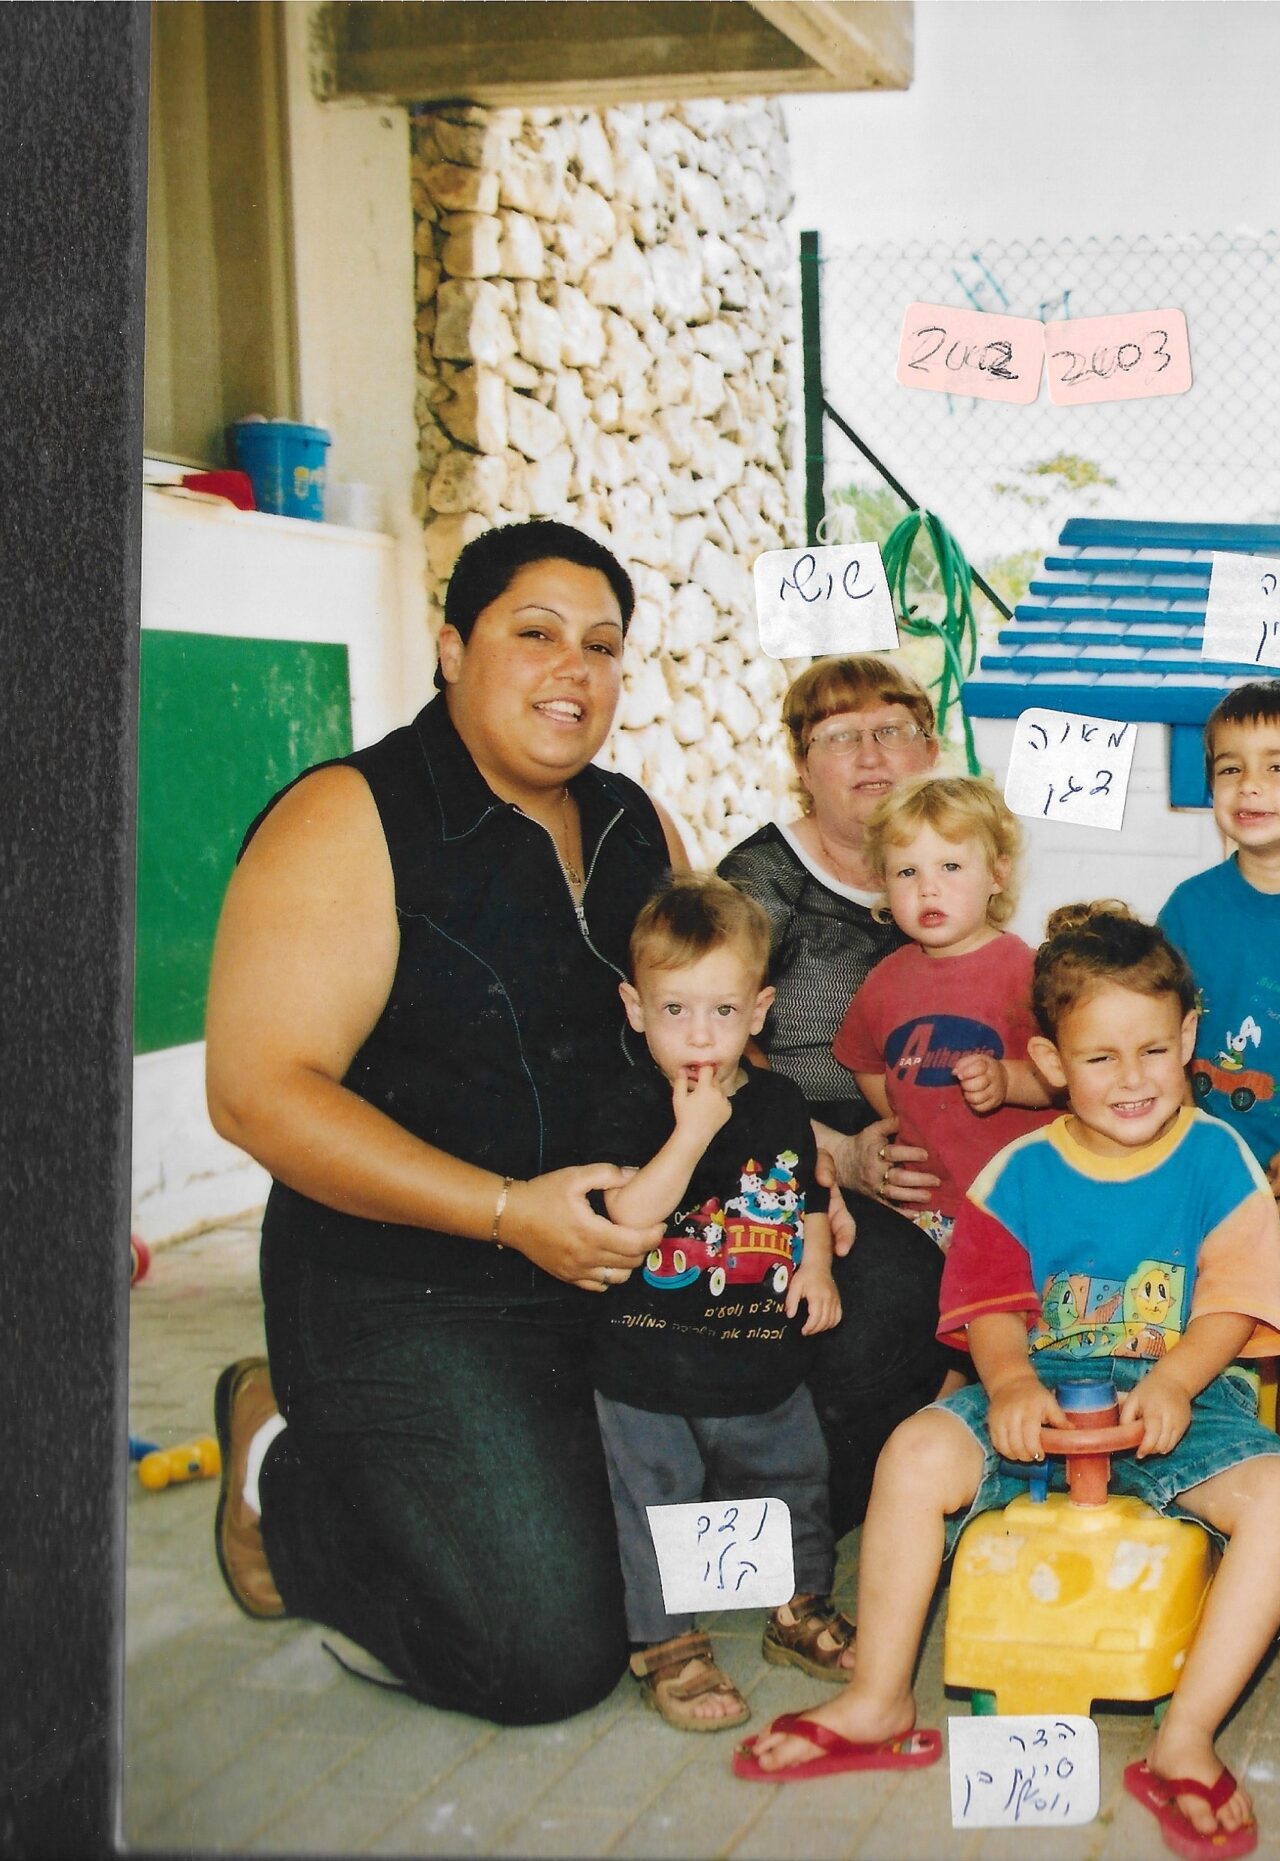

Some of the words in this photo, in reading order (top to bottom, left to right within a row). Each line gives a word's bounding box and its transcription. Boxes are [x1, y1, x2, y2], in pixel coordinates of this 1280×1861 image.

[1052, 330, 1171, 386] 2003
[704, 1303, 744, 1318] נוסעים
[749, 1299, 785, 1313] מיצים
[720, 1327, 741, 1340] את
[746, 1325, 788, 1339] לכבות
